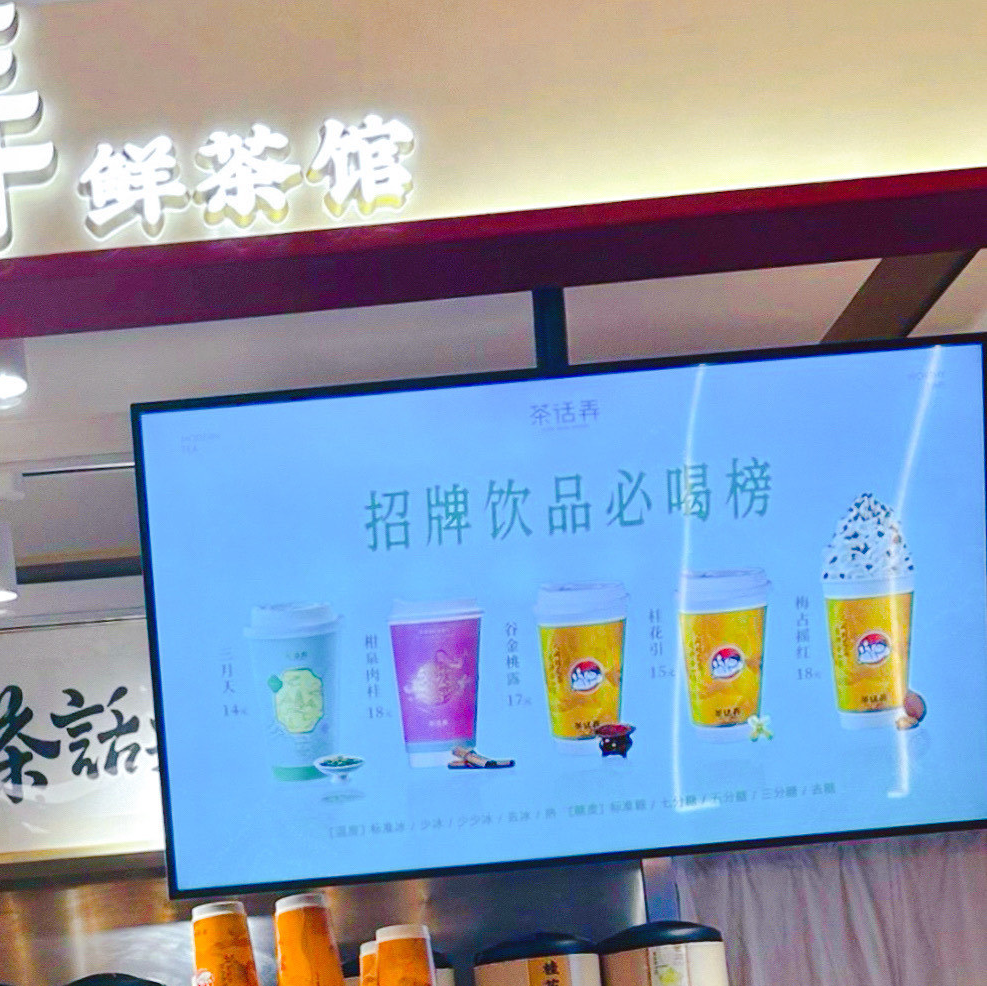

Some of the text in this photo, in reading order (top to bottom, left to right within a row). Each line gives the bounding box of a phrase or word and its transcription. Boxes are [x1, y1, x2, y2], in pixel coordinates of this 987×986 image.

[79, 115, 414, 237] 鲜茶馆
[529, 400, 600, 426] 茶话弄
[365, 457, 771, 551] 招牌饮品必喝榜
